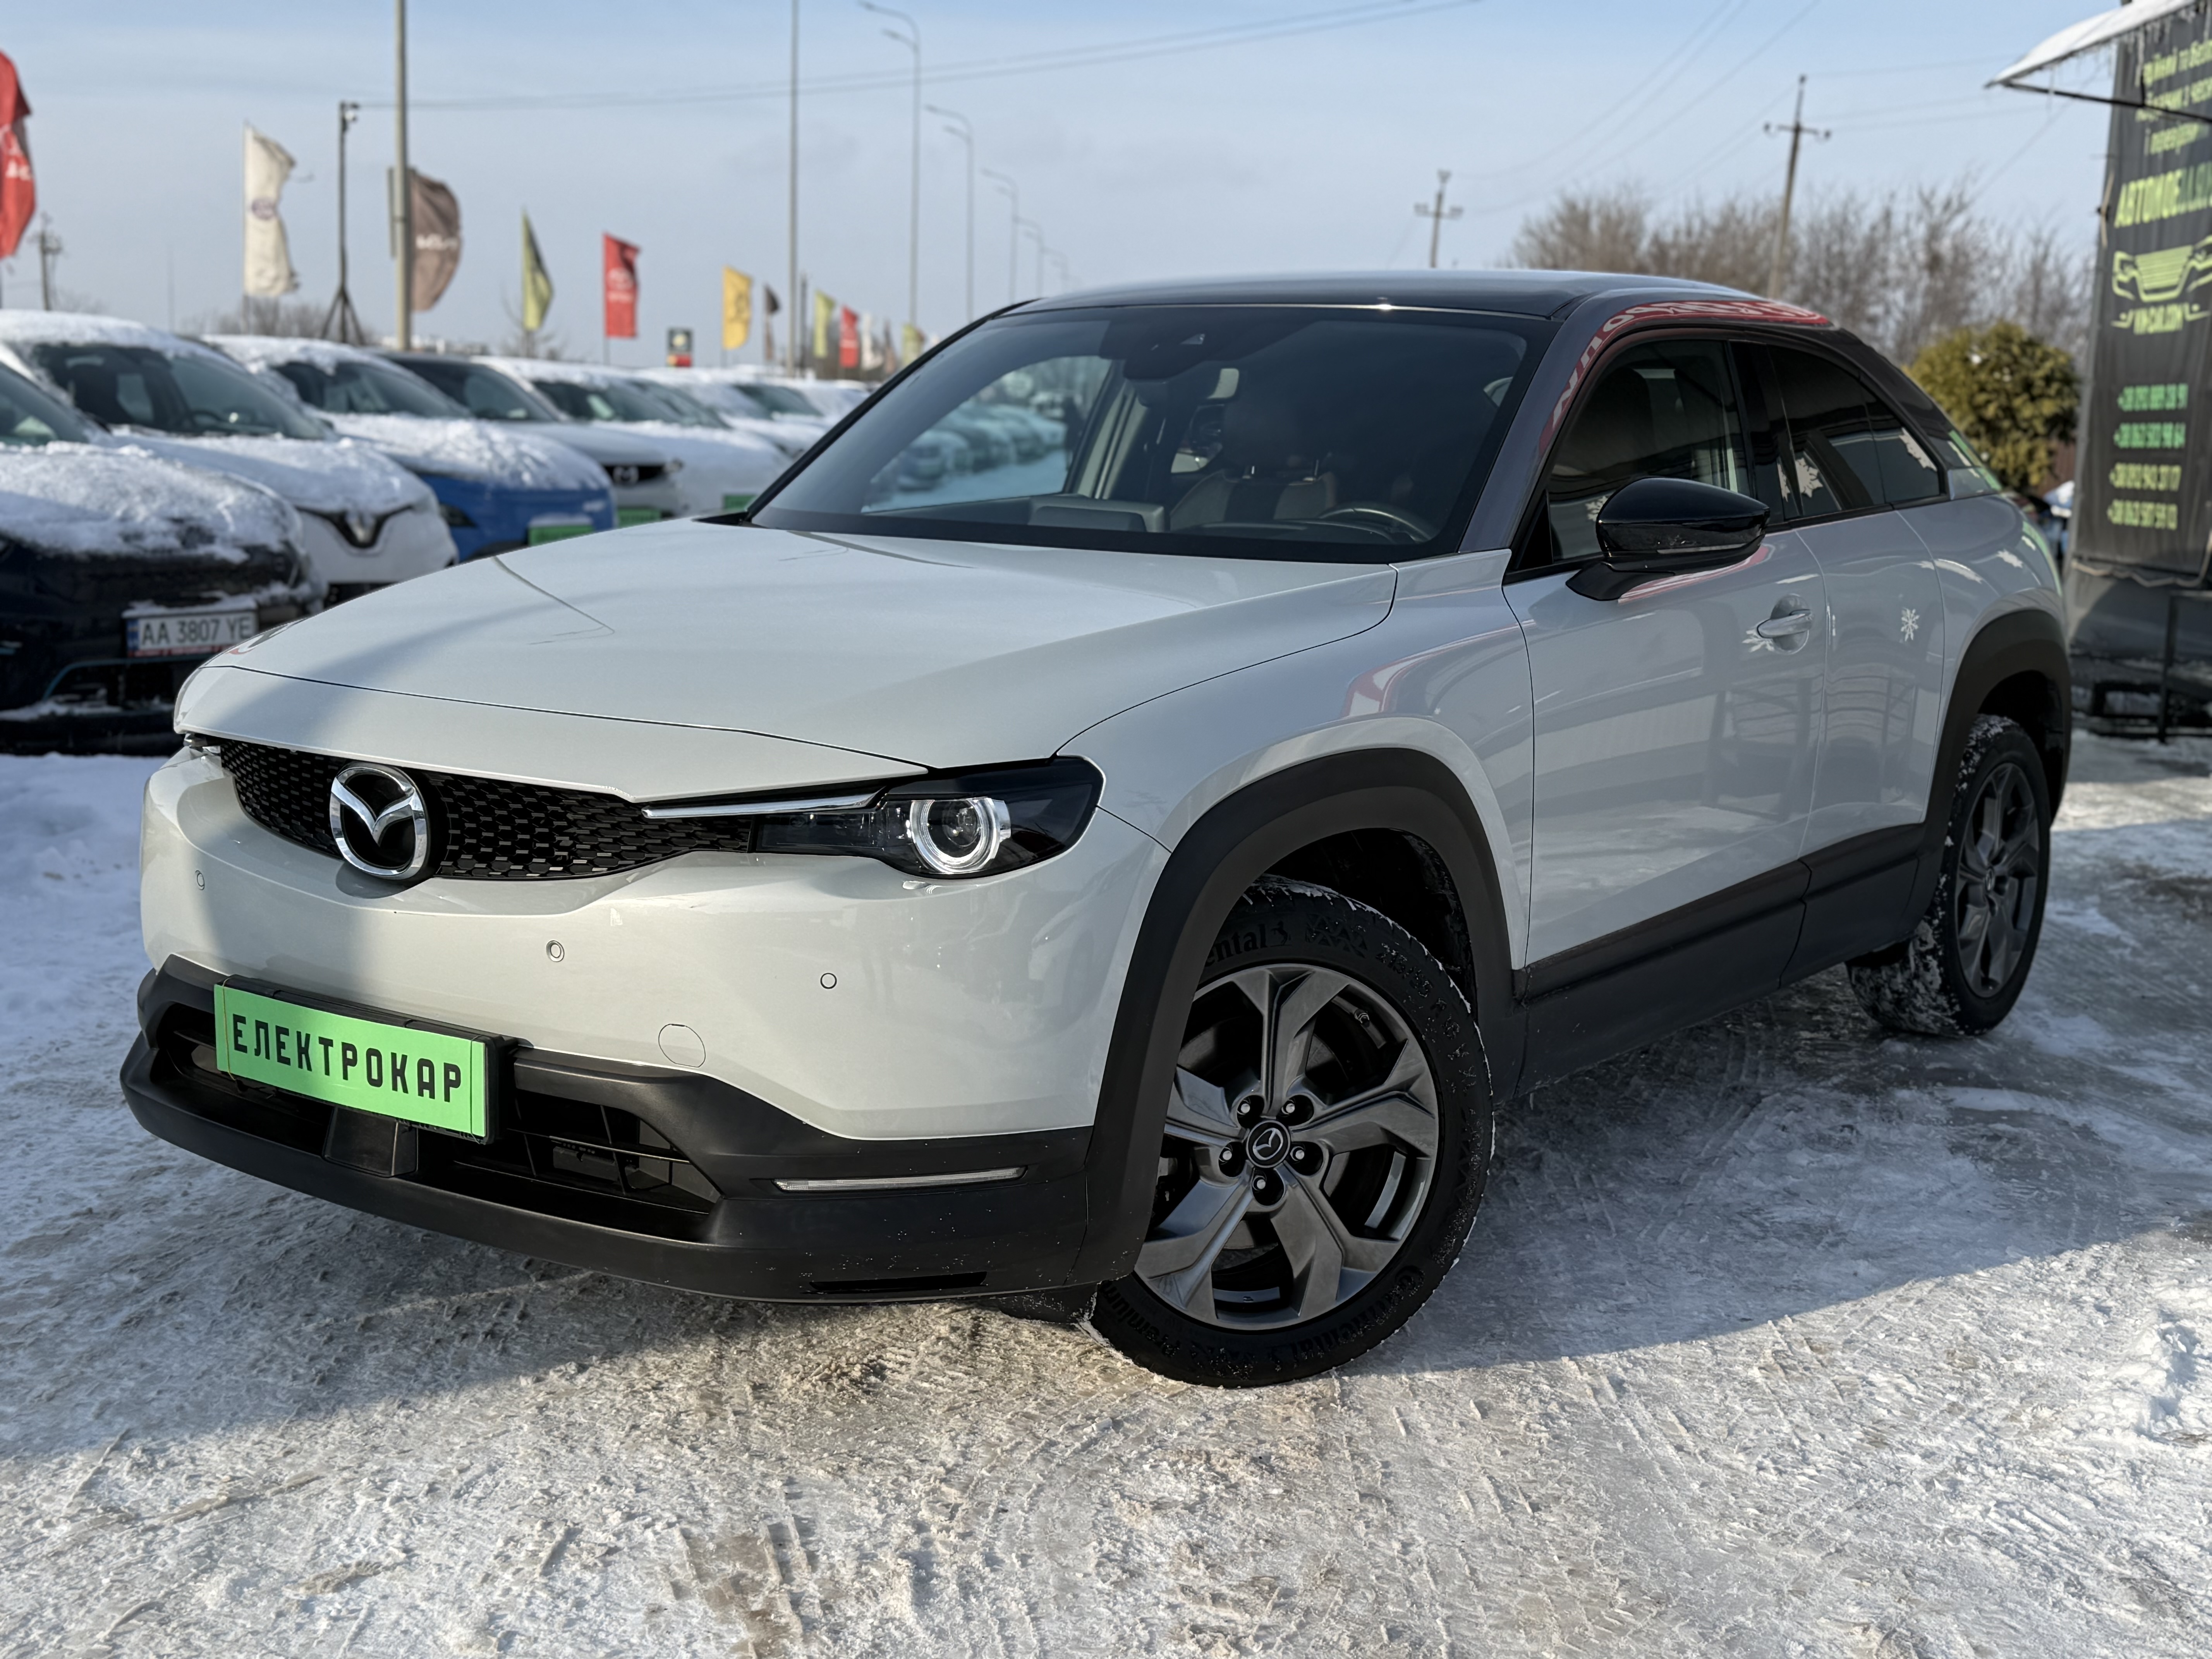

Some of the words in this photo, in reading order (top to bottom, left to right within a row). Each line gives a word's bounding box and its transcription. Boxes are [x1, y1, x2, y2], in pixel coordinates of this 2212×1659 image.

[142, 621, 170, 646] AA
[177, 620, 220, 643] 3807
[227, 617, 251, 640] YE
[232, 1013, 461, 1103] ЕЛЕКТРОКАР
